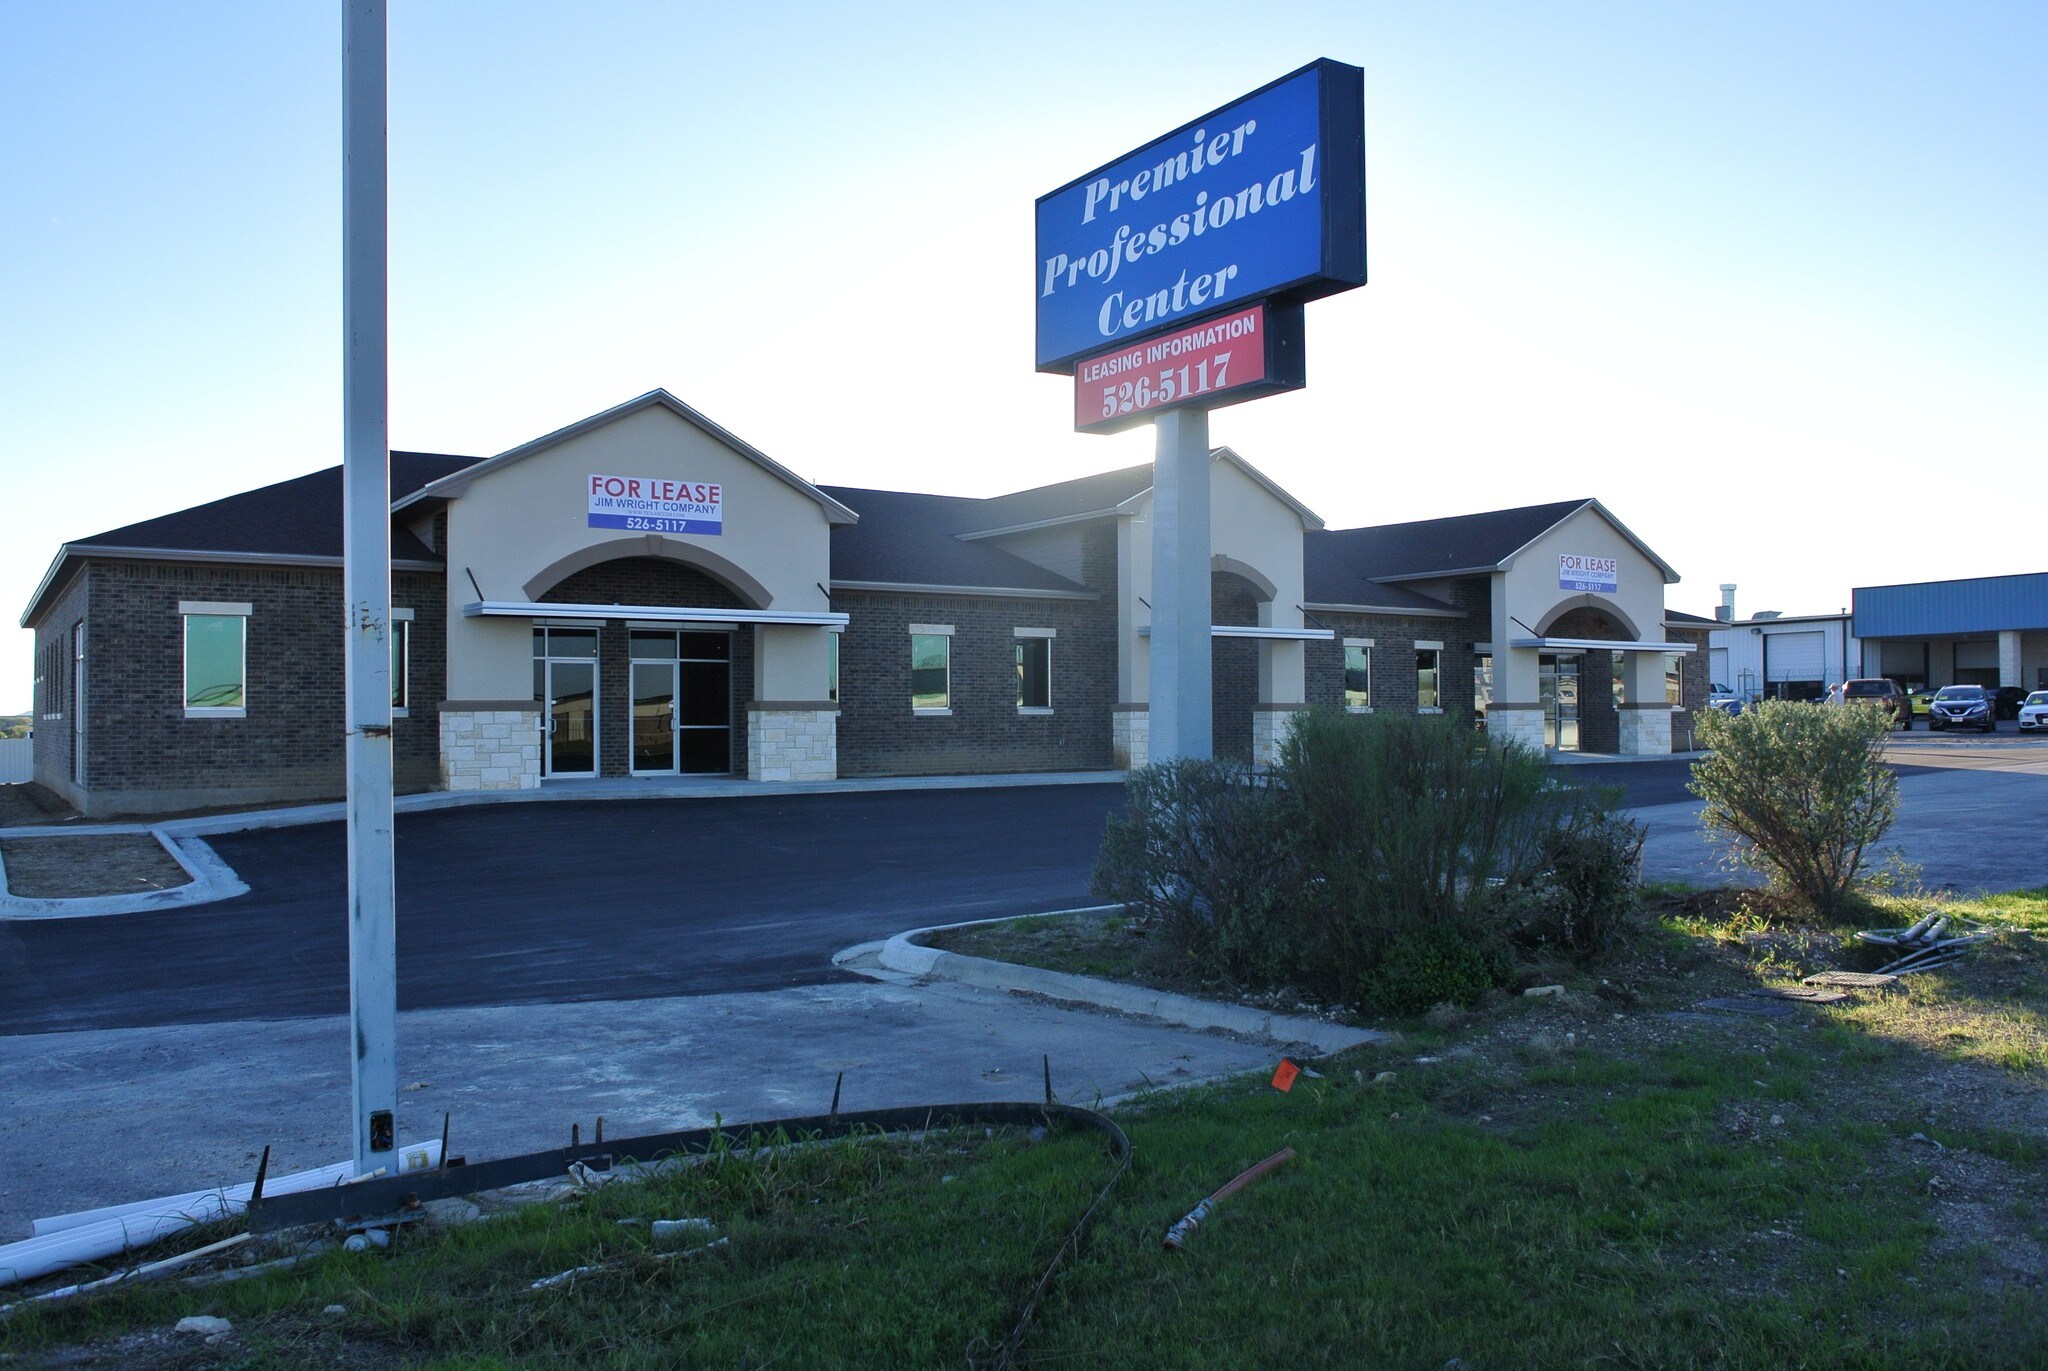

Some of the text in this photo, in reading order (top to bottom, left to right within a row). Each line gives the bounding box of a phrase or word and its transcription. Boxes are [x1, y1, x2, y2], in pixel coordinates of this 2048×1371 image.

[1081, 119, 1256, 225] Premier
[1041, 143, 1317, 298] Professional
[1098, 264, 1238, 336] Center
[1084, 315, 1255, 383] LEASING INFORMATION
[1102, 350, 1232, 418] 526-5117
[592, 477, 720, 504] FOR LEASE
[595, 497, 717, 515] JIM WRIGHT COMPANY
[626, 517, 687, 532] 526-5117
[1561, 556, 1615, 573] FOR LEASE
[1575, 582, 1601, 591] 526-5117
